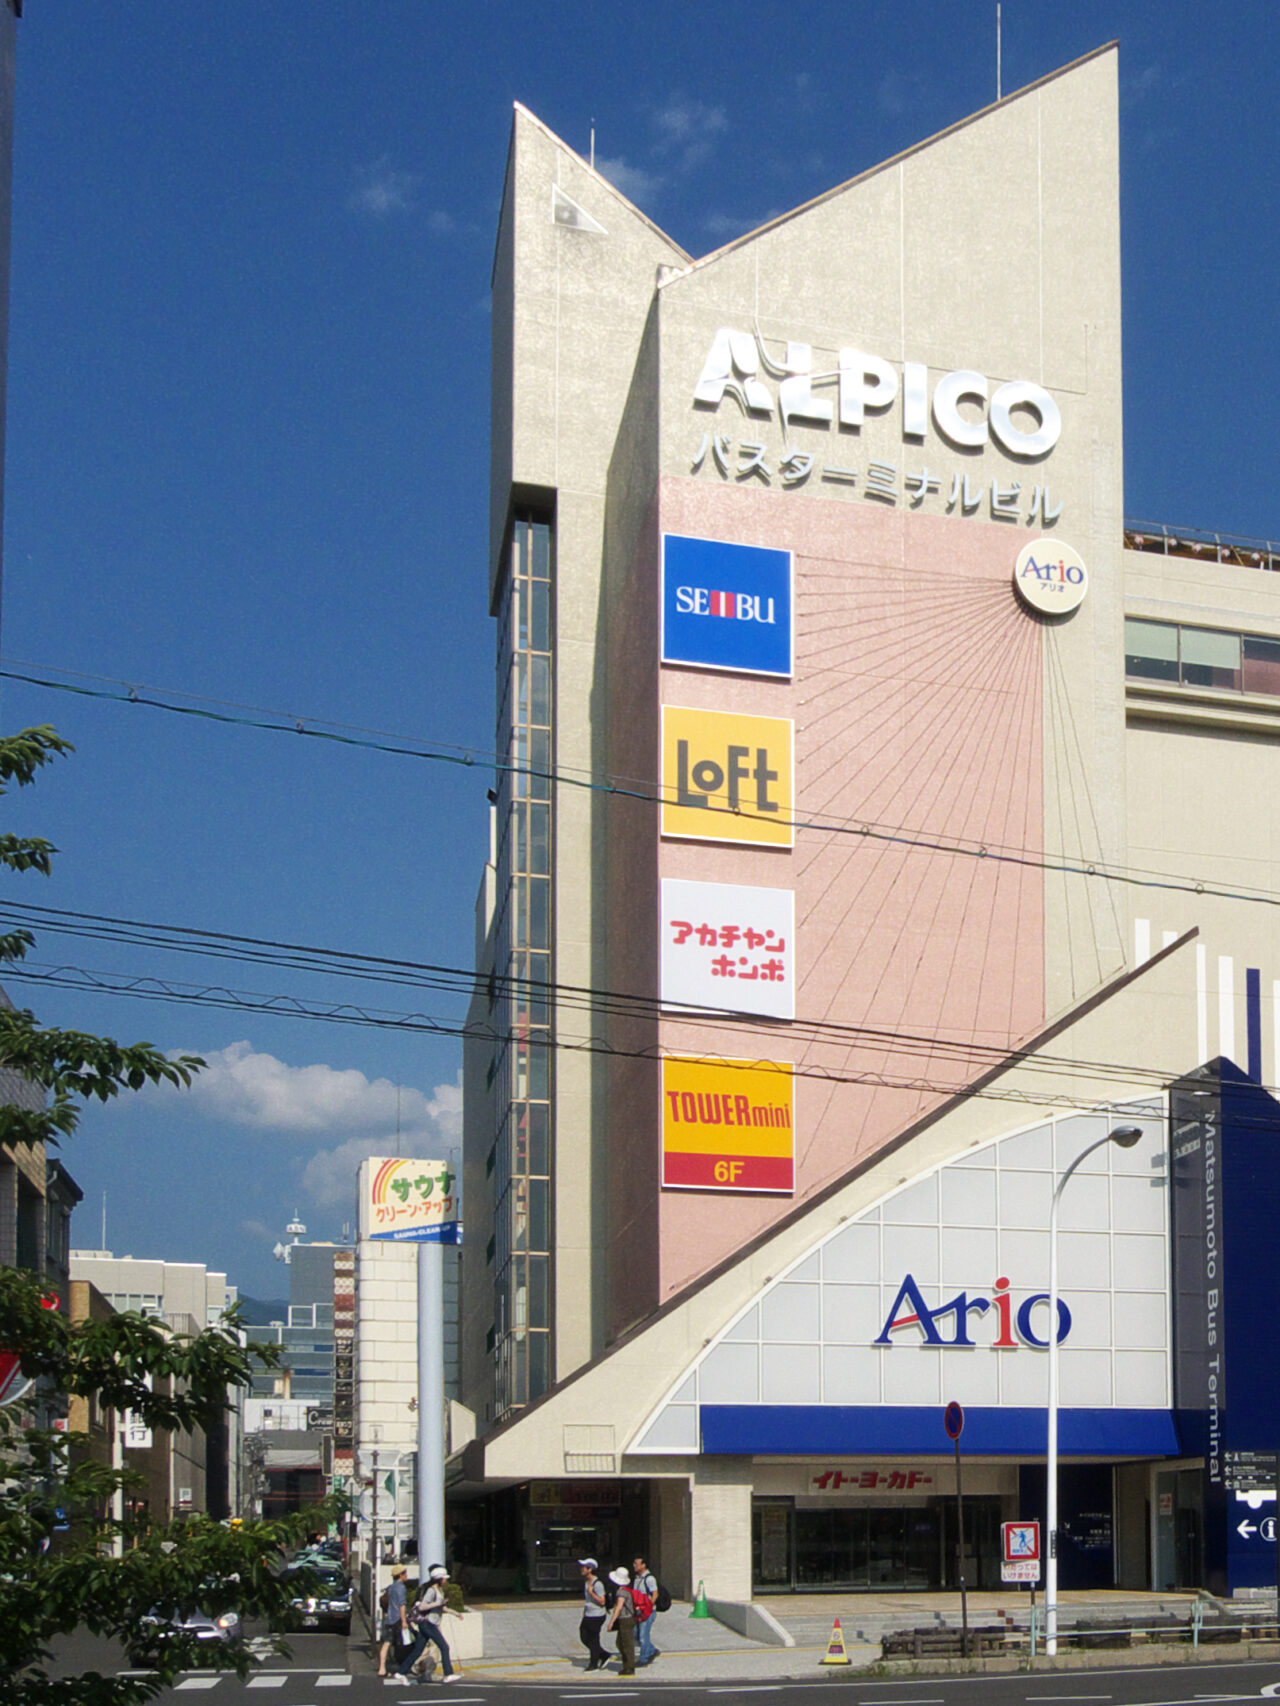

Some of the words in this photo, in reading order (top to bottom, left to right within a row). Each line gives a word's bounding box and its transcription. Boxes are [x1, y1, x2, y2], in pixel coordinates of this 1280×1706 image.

[693, 320, 1062, 456] ALPICO
[692, 432, 1064, 525] バスターミナルビル
[1021, 555, 1084, 585] Ario
[1040, 582, 1065, 593] アリオ
[676, 586, 776, 624] SEIBU
[670, 920, 785, 953] アカチャン
[391, 1171, 456, 1203] サウナ
[714, 1160, 745, 1183] 6F
[1205, 1109, 1217, 1279] Matsumoto
[873, 1273, 1072, 1347] Ario
[1207, 1289, 1219, 1347] Bus
[1208, 1353, 1221, 1482] Terminal
[813, 1470, 933, 1490] イトーヨーカドー
